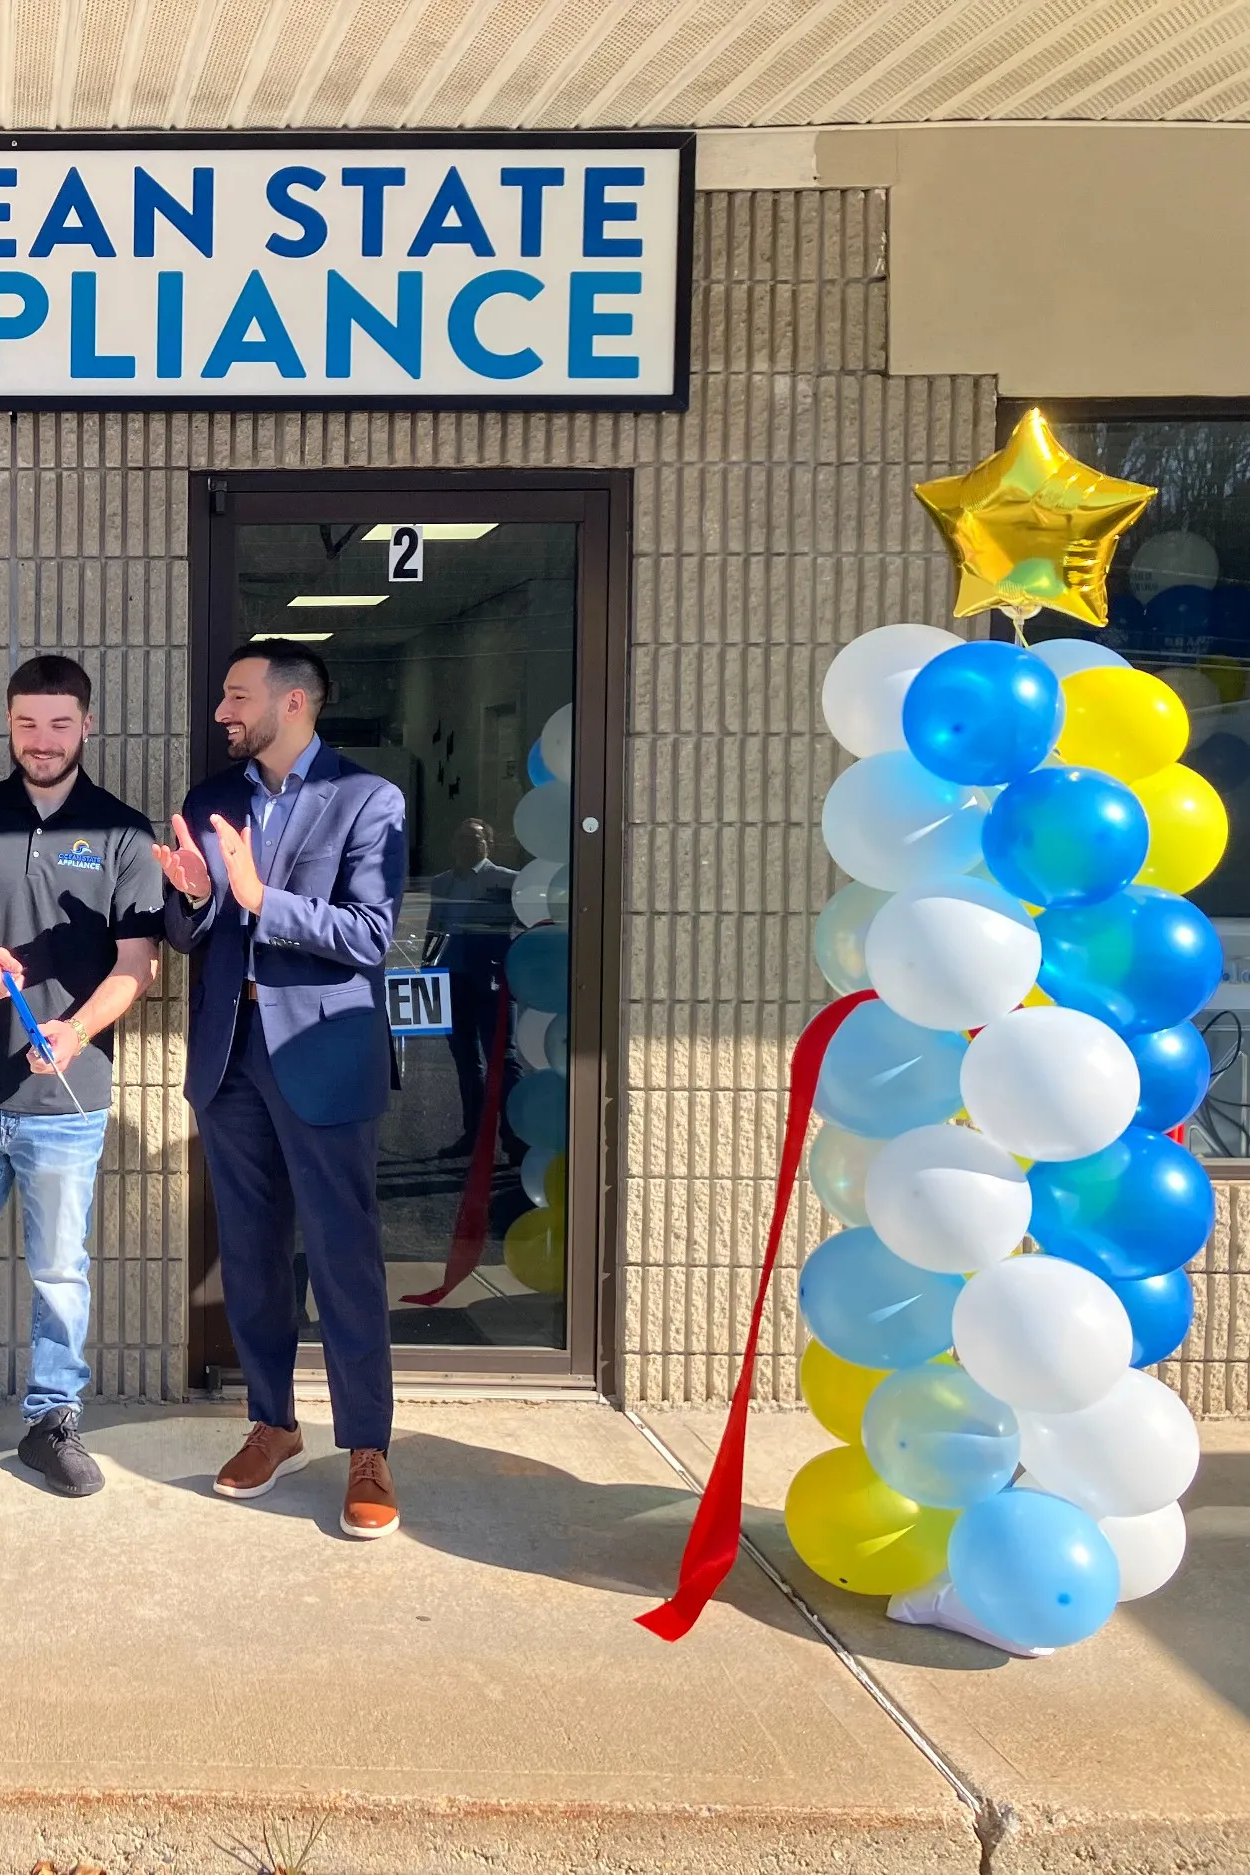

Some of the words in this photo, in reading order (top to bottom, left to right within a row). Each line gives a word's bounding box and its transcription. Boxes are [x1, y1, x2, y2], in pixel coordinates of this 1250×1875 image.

[266, 166, 644, 258] STATE
[392, 528, 419, 579] 2
[57, 859, 101, 870] APPLIANCE
[58, 853, 81, 861] OCEAN
[81, 855, 101, 863] STATE
